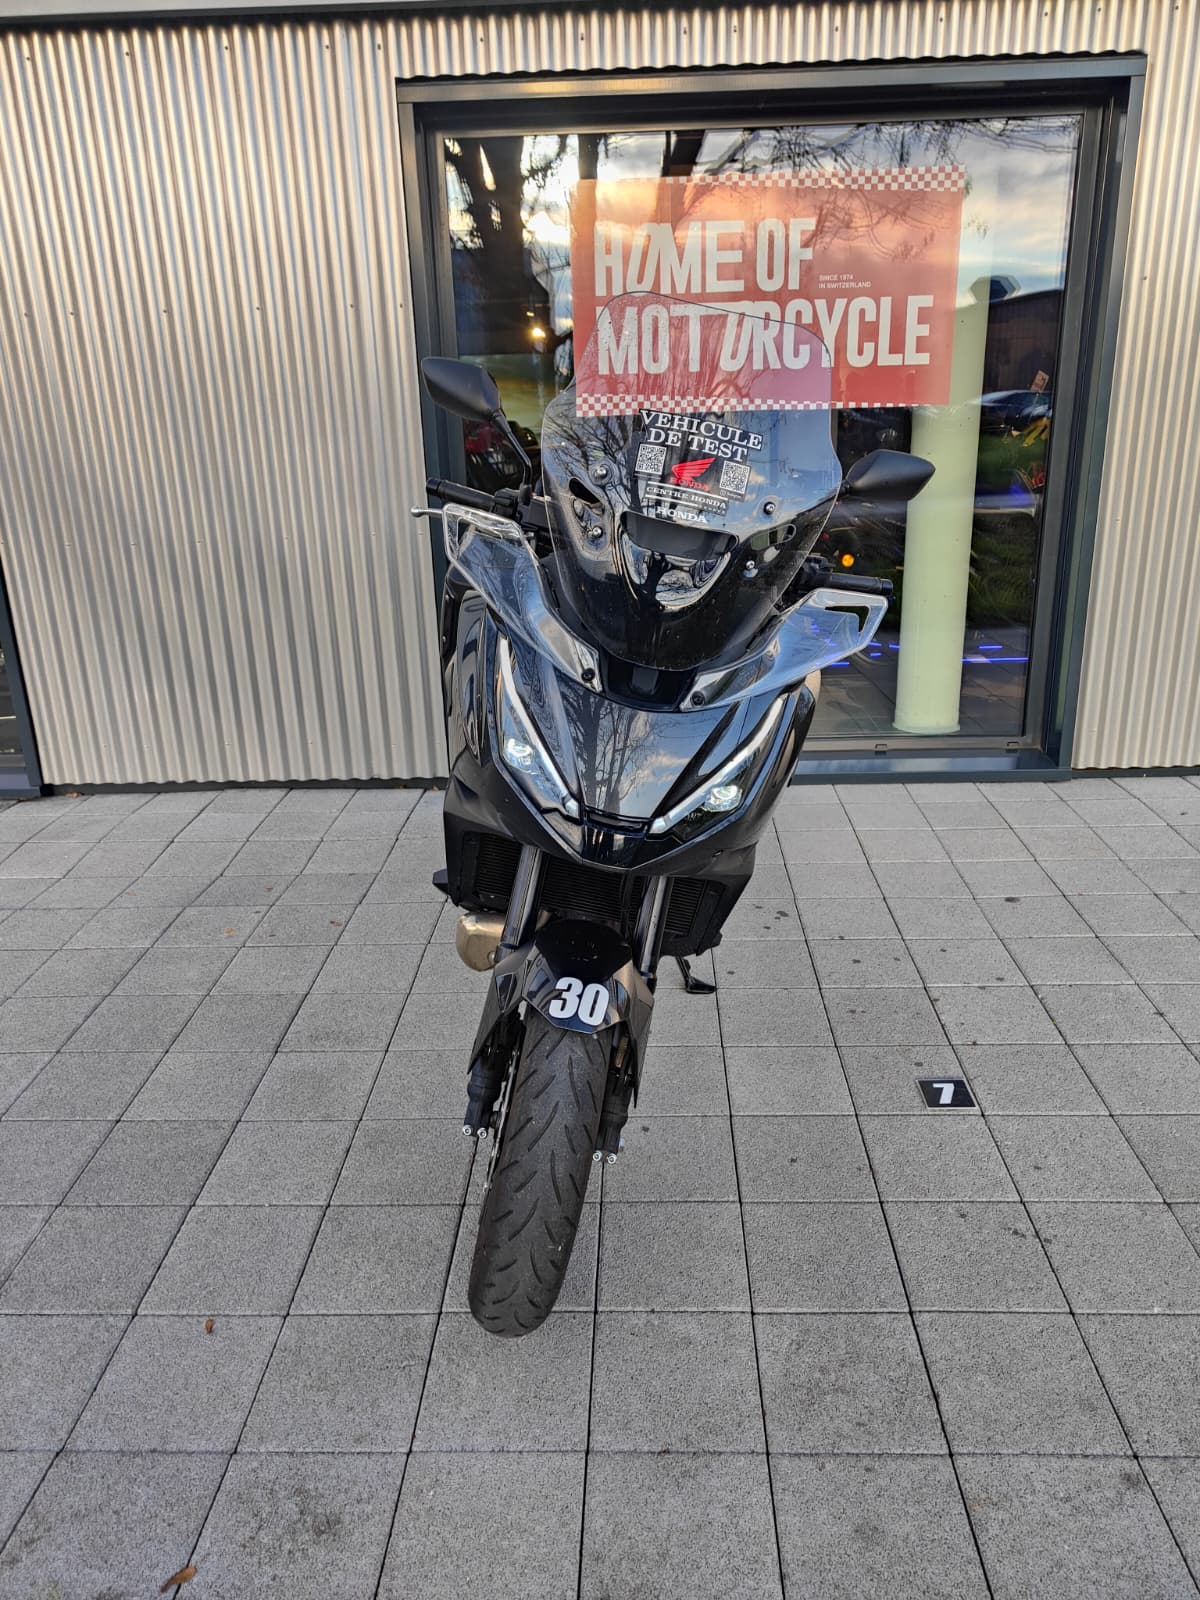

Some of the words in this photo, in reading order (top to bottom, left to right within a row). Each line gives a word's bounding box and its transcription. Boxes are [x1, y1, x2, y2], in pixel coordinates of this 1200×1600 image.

[594, 220, 745, 297] HOME
[756, 218, 817, 291] OF
[827, 281, 871, 289] SWITZERLAND
[595, 295, 935, 376] MOTORCYCLE
[640, 410, 762, 451] VEHICULE
[647, 428, 682, 447] DE
[688, 435, 747, 462] TEST
[646, 486, 689, 500] CENTRE
[691, 494, 727, 509] HONDA
[656, 506, 708, 524] HONDA
[549, 976, 610, 1026] 30
[932, 1082, 955, 1105] 7
